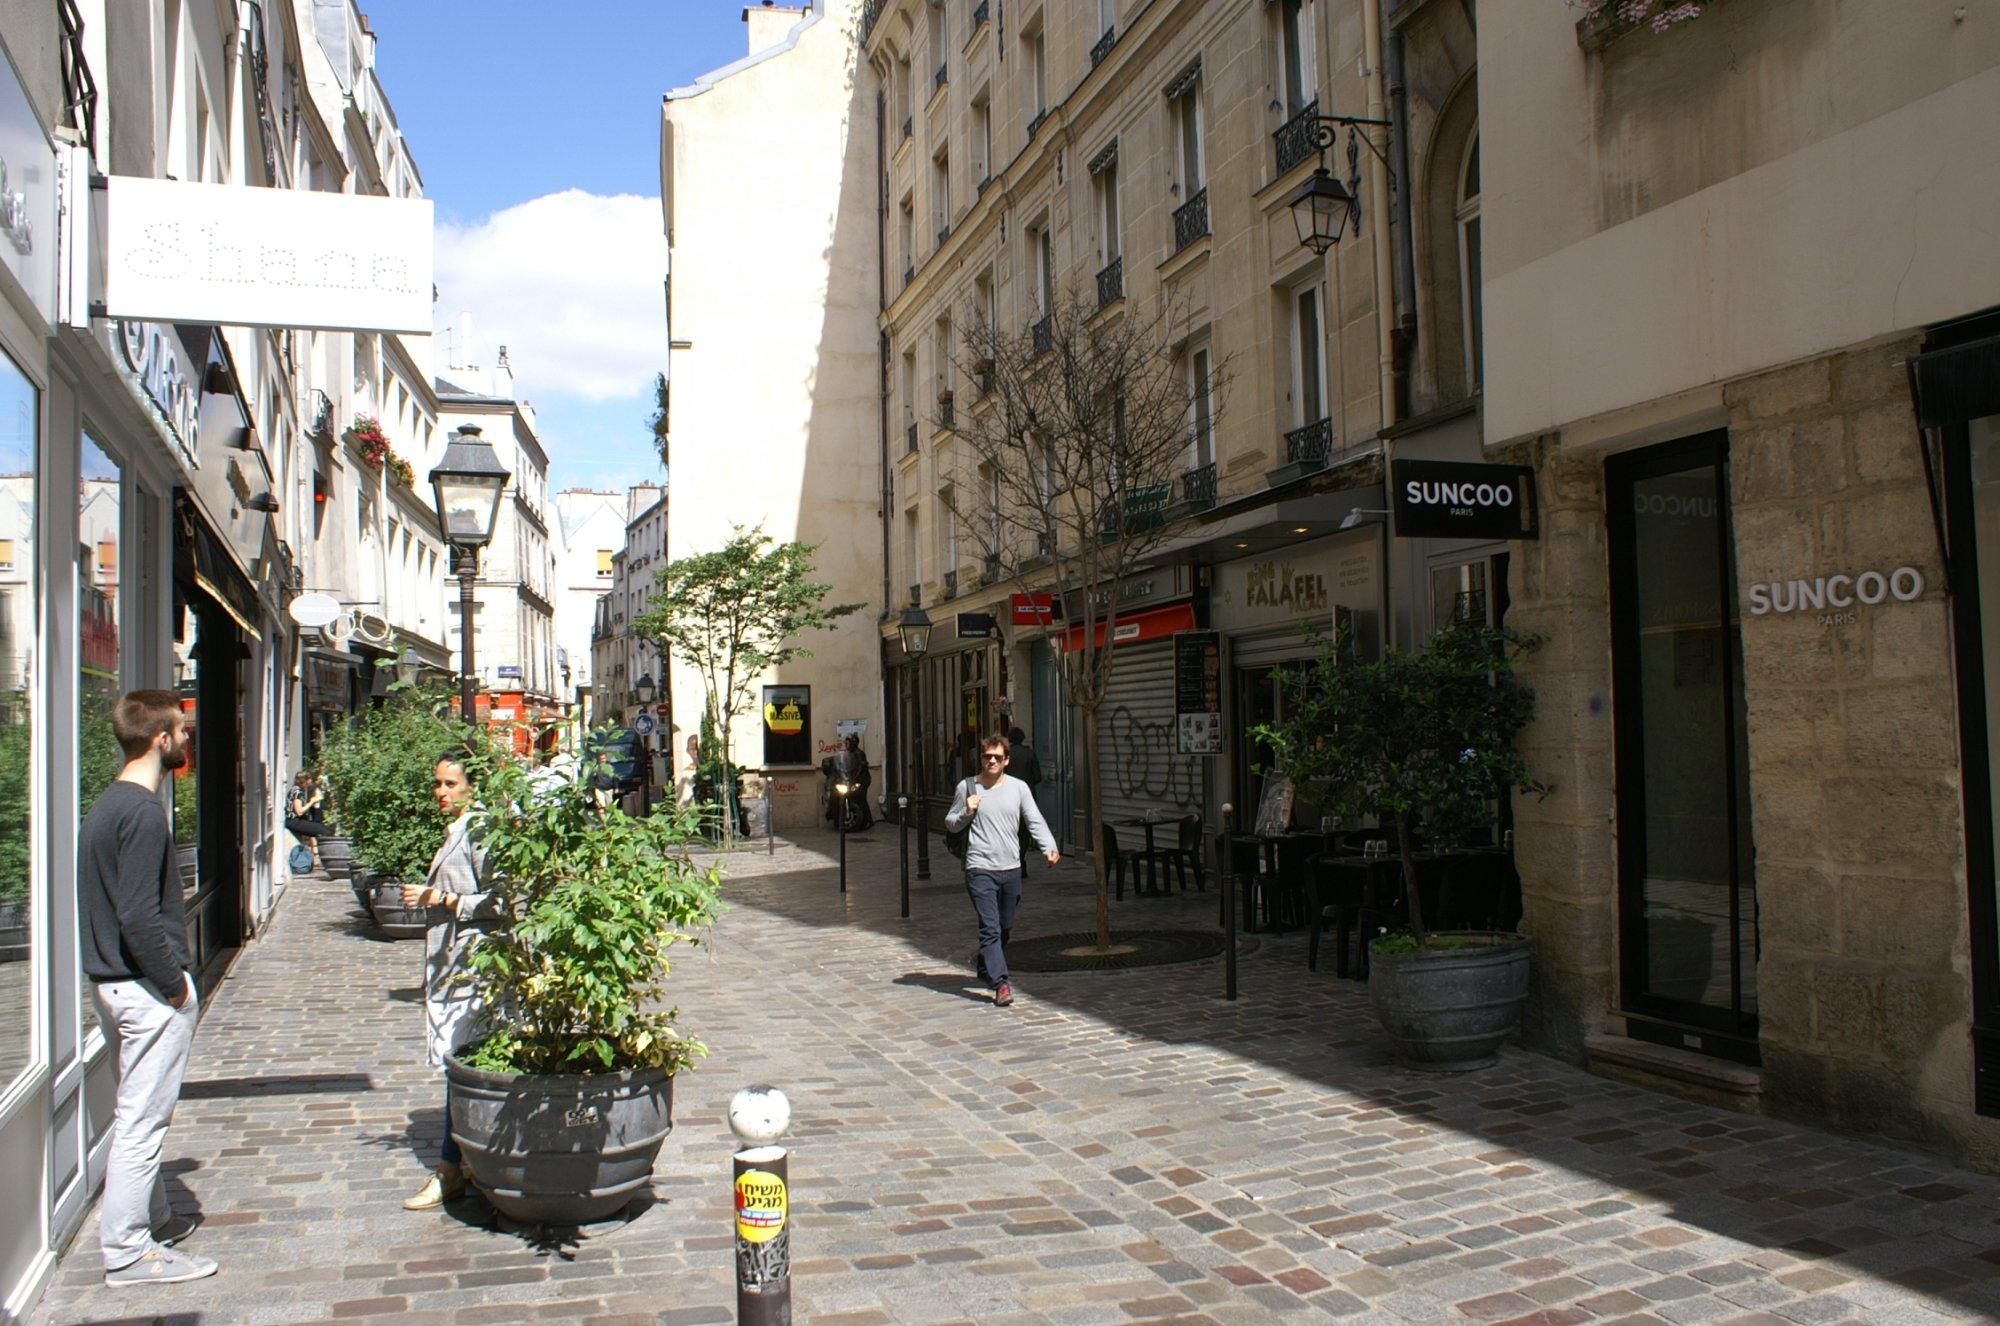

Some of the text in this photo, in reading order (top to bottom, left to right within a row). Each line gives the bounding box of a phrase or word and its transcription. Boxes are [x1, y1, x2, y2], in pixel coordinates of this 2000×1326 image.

[124, 222, 419, 295] Shana
[1406, 481, 1513, 507] SUNCOO
[1450, 508, 1474, 517] PARIS
[1247, 574, 1328, 607] FALAFEL
[1749, 566, 1925, 615] SUNCOO
[1816, 613, 1857, 626] PARIS
[770, 711, 800, 720] MASSIVE
[745, 1183, 783, 1196] משיח
[745, 1196, 783, 1208] מגיע
